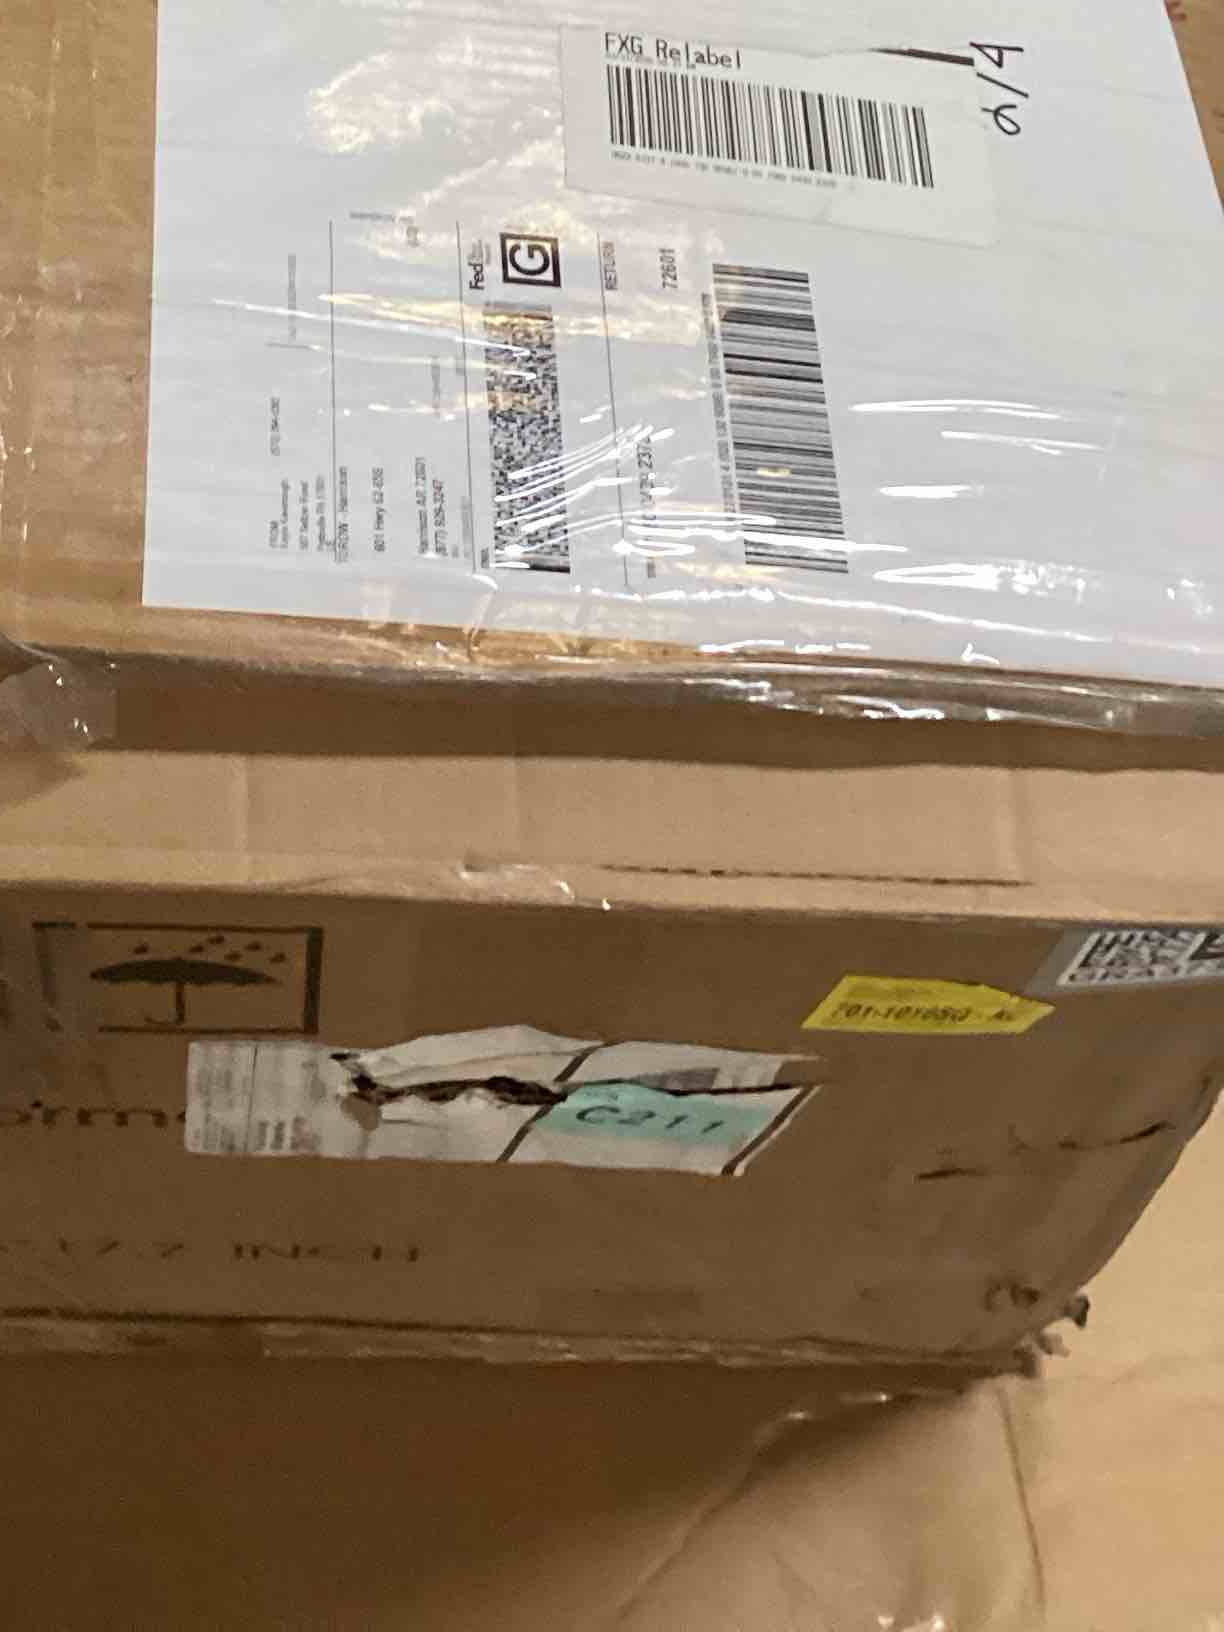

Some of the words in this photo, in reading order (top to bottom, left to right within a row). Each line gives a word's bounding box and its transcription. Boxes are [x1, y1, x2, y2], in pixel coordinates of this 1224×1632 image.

[604, 32, 643, 55] FXG
[656, 38, 742, 70] Relabel
[660, 247, 679, 290] 72601
[576, 1103, 726, 1137] C211
